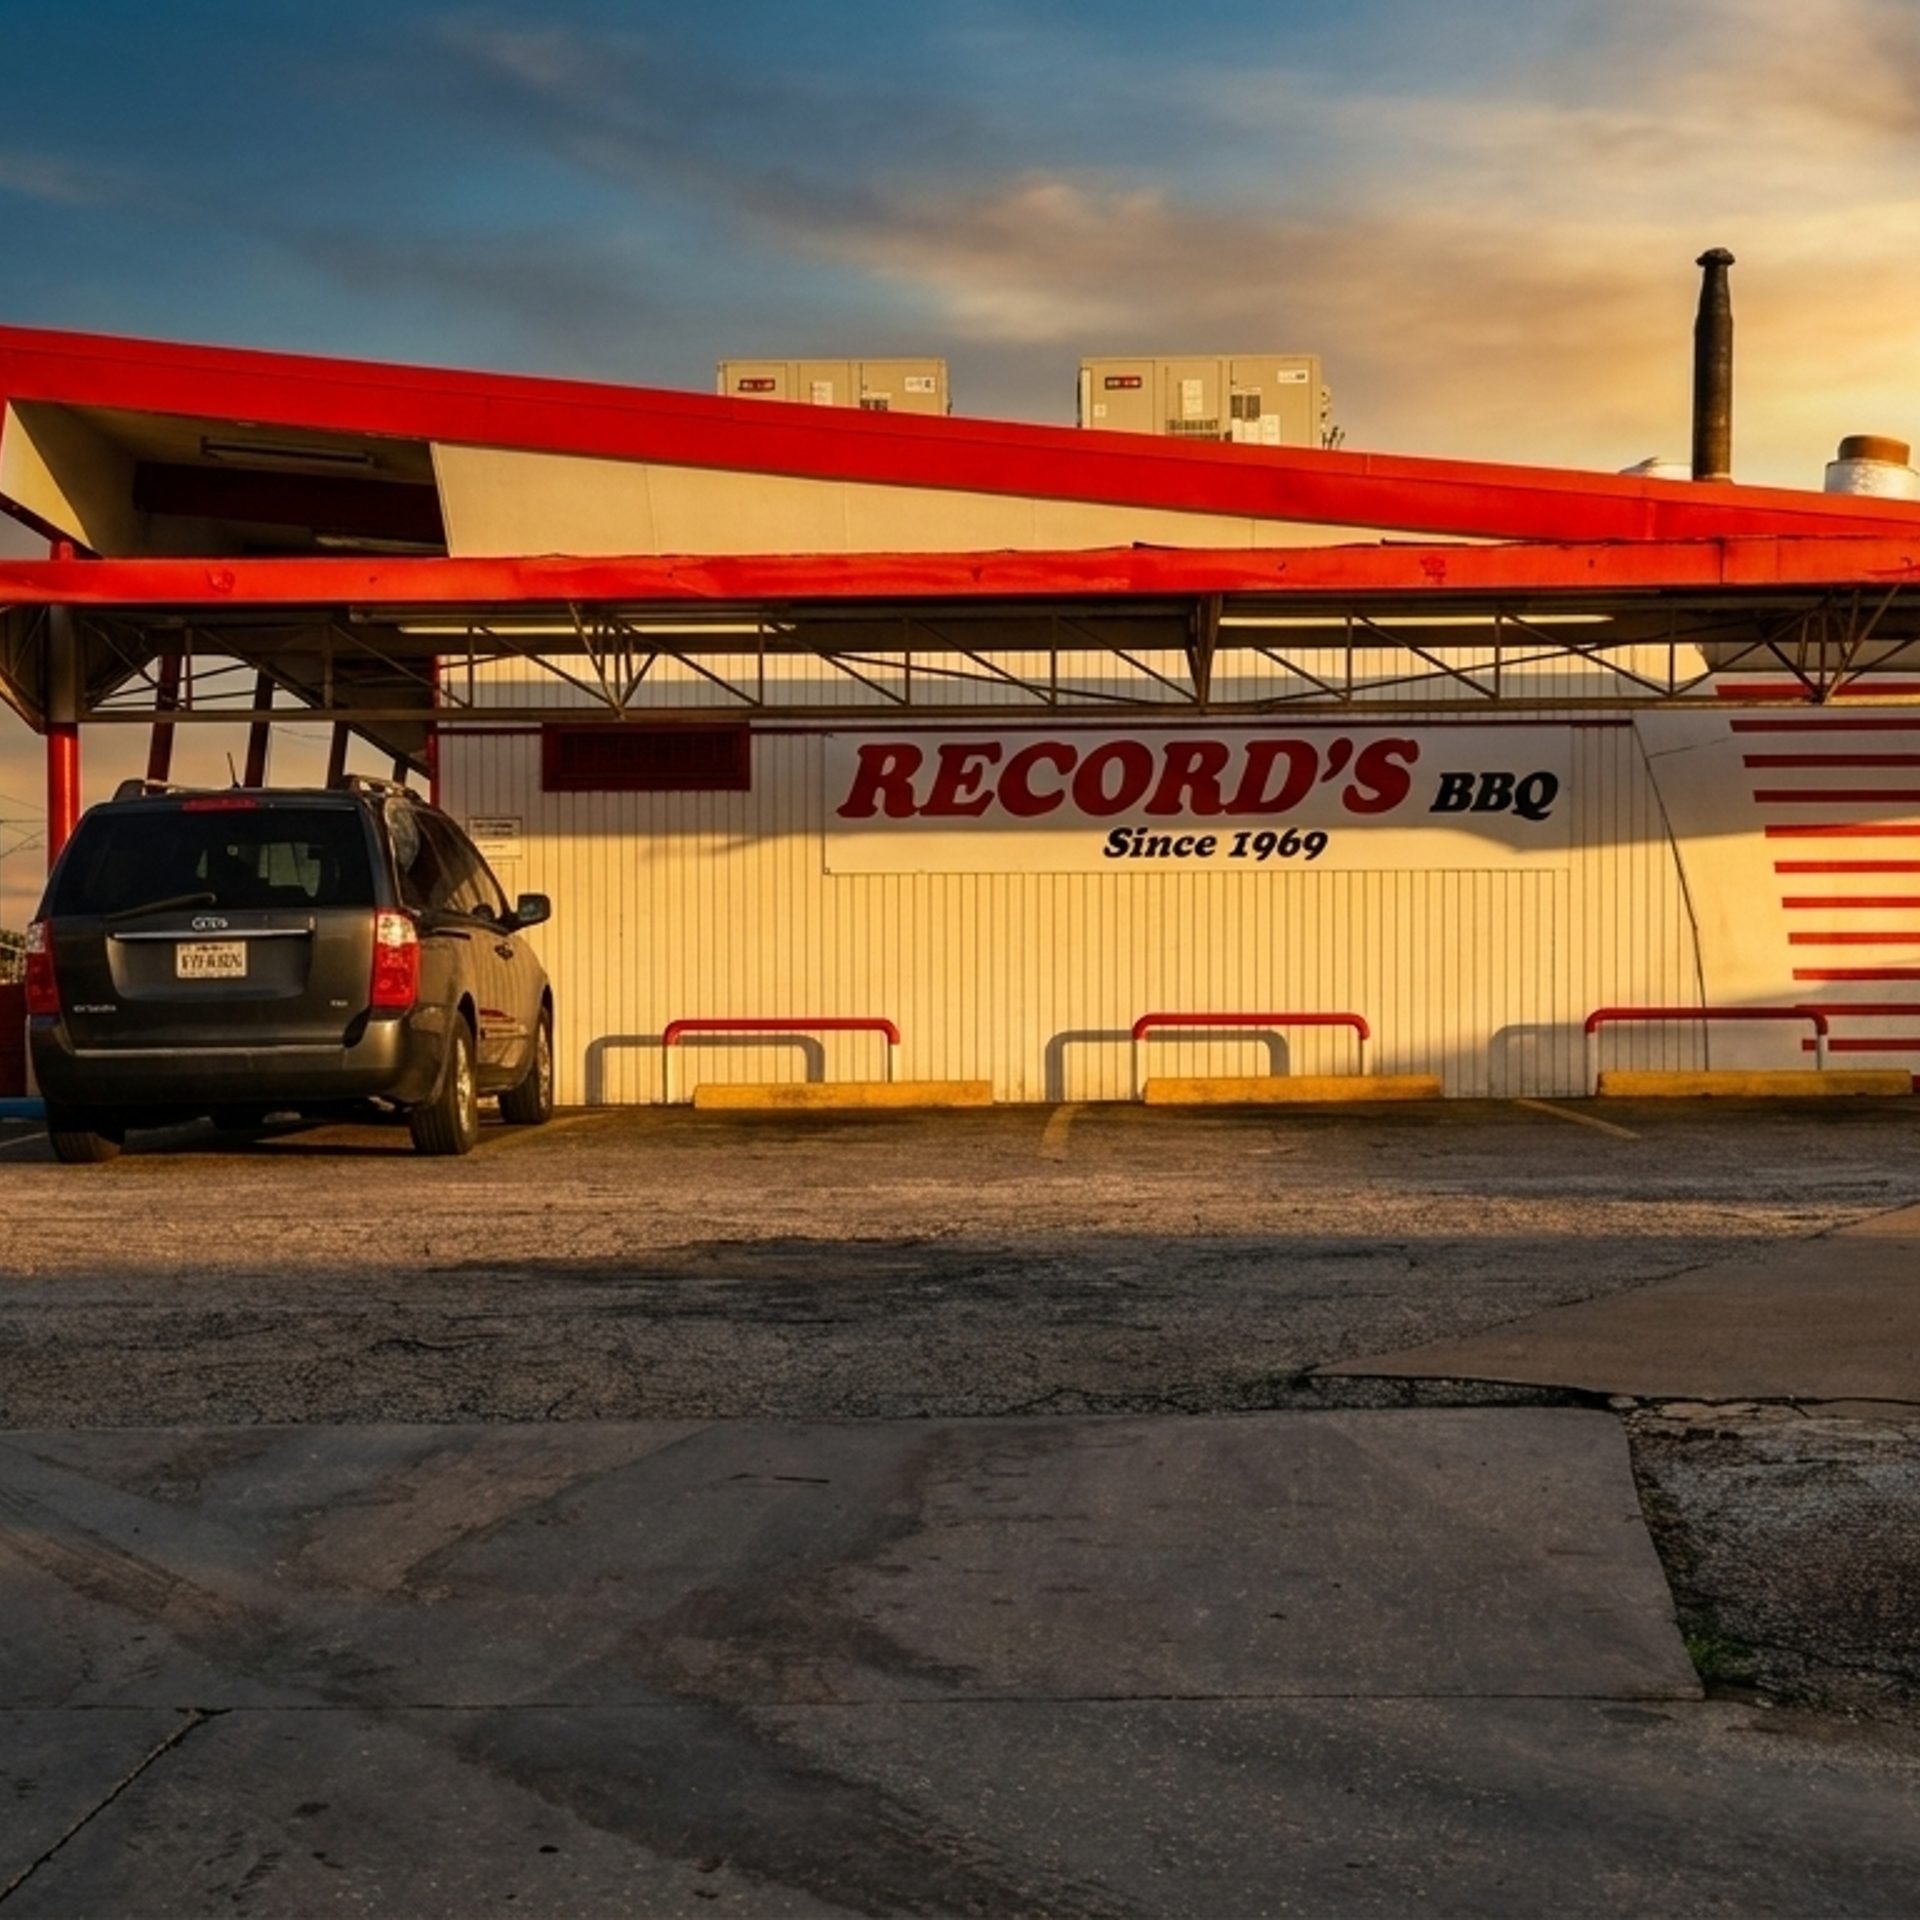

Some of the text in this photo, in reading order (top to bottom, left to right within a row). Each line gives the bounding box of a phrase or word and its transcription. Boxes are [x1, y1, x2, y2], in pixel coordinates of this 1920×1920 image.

[837, 738, 1558, 820] RECORD'S BBQ
[1103, 827, 1328, 861] Since 1969
